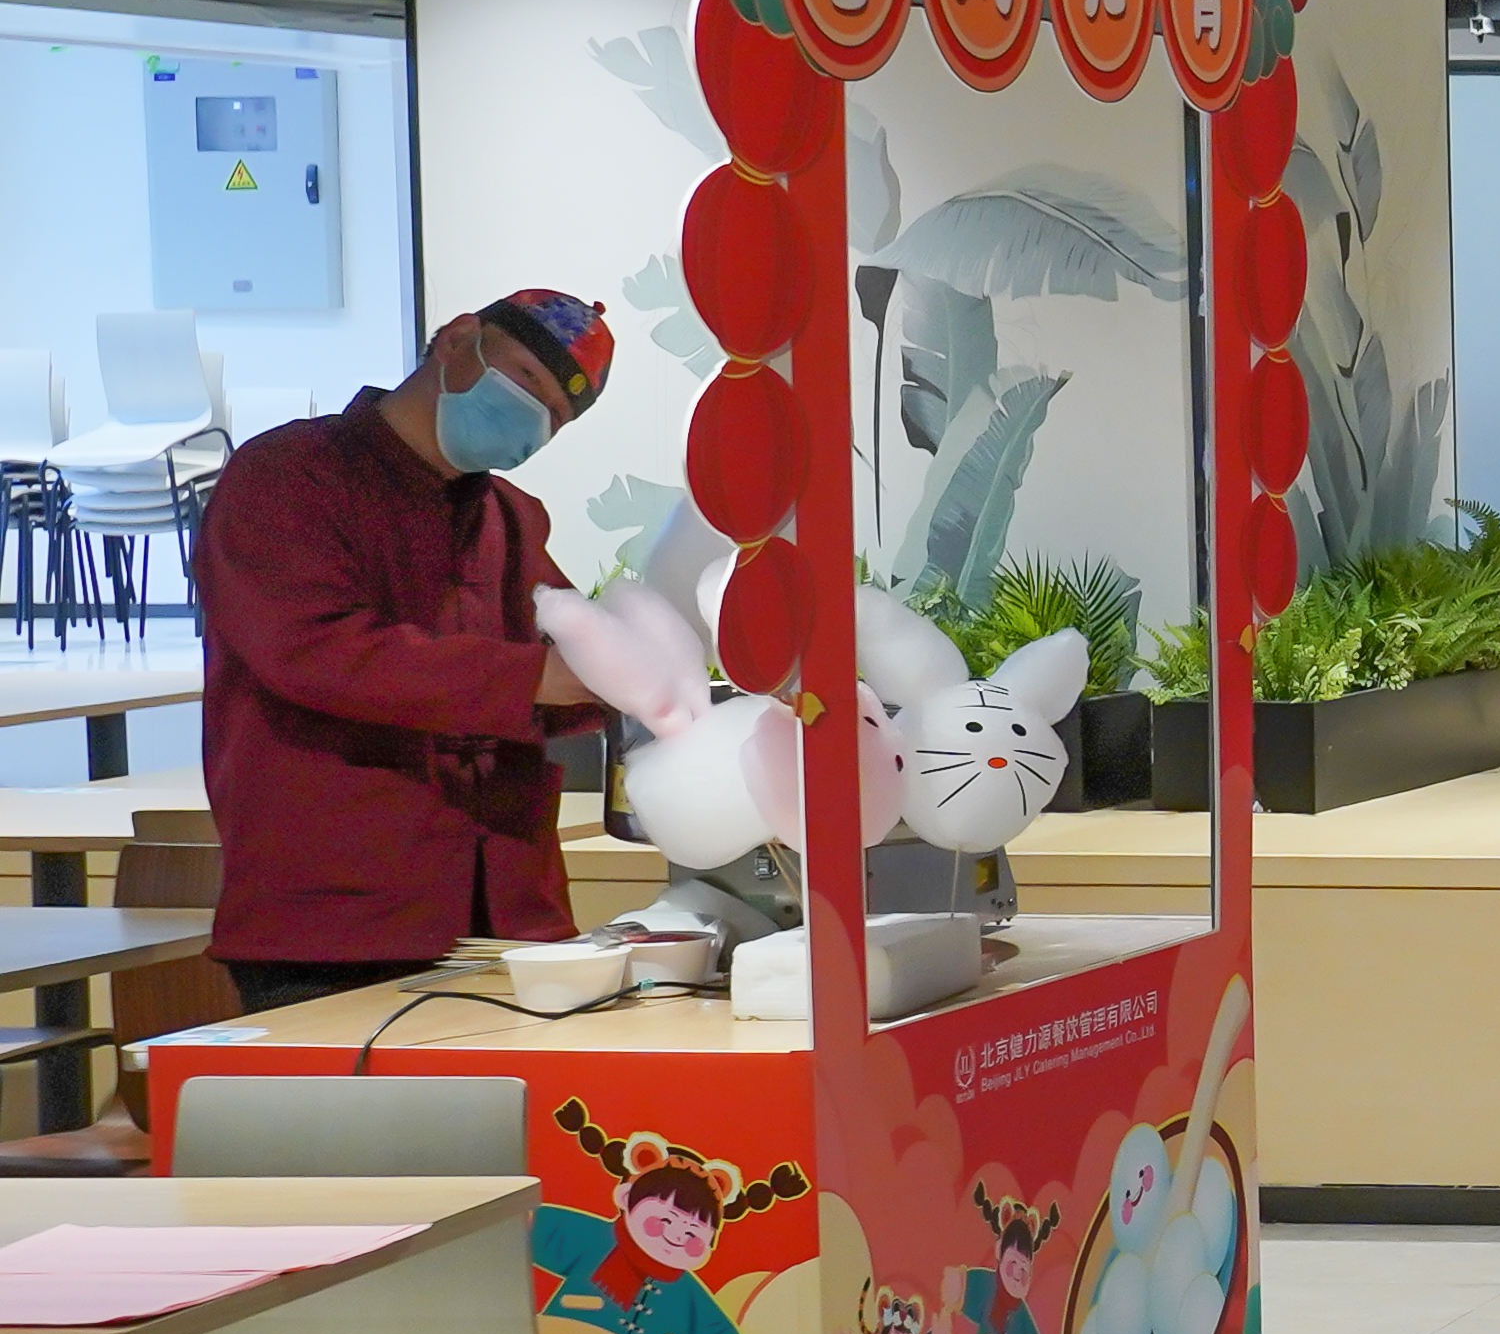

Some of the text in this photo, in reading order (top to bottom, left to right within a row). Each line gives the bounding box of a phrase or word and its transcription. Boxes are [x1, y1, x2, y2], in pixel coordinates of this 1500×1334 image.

[980, 990, 1159, 1068] 北京健力源餐饮管理有限公司
